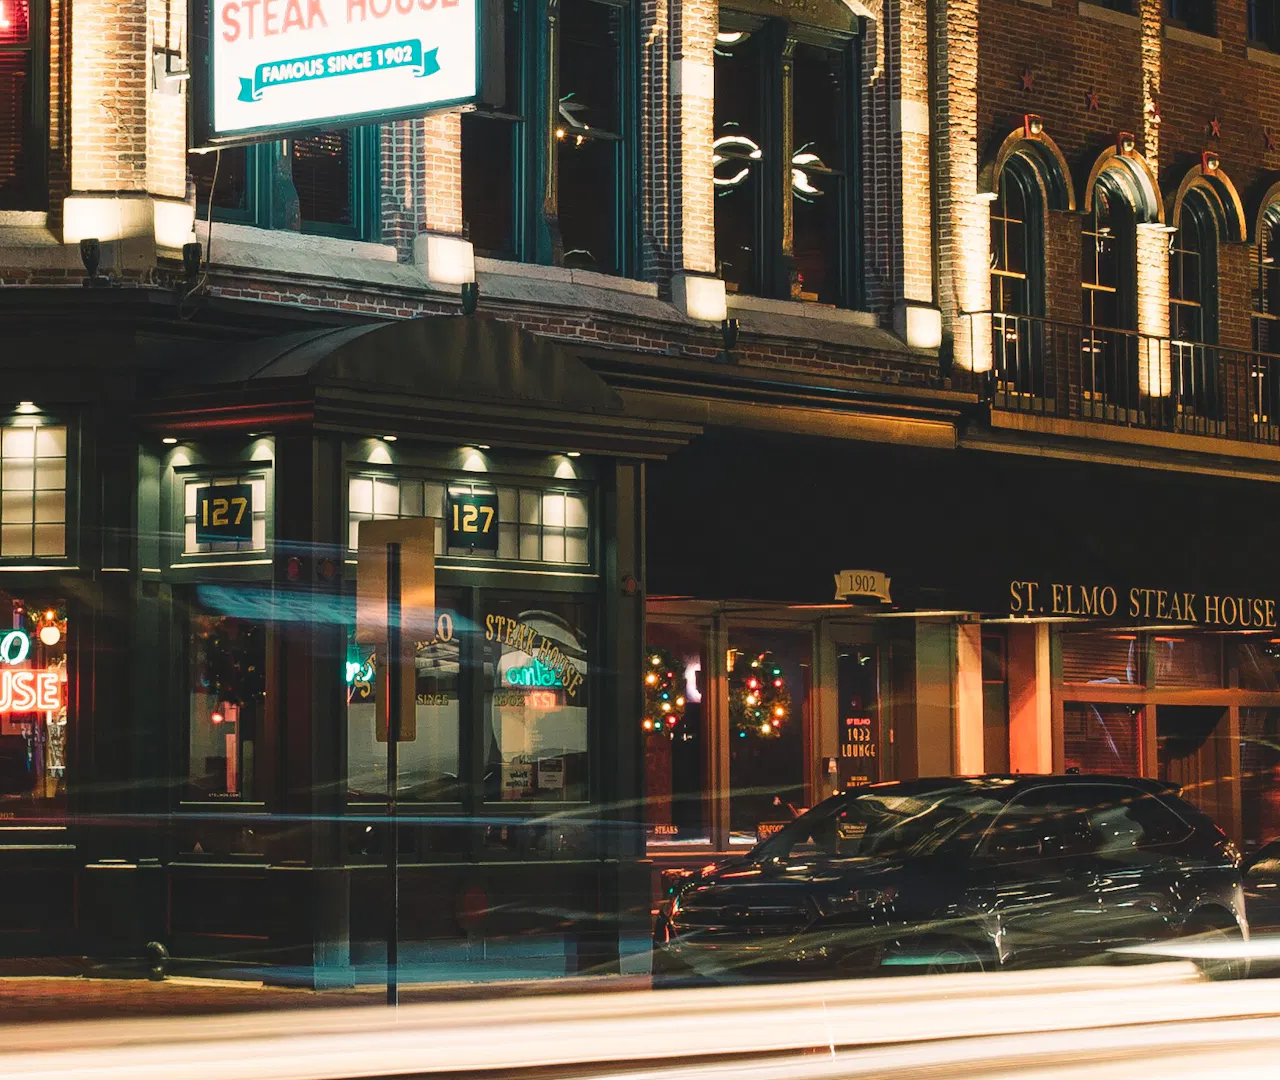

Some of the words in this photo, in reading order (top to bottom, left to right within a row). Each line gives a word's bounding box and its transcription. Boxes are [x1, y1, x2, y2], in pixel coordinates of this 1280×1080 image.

[262, 58, 324, 83] FAMOUS
[327, 52, 372, 73] SINCE
[377, 45, 413, 66] 1902
[202, 497, 248, 527] 127
[453, 505, 494, 533] 127
[849, 575, 876, 592] 1902
[1010, 580, 1044, 612] ST.
[1051, 584, 1117, 616] ELMO
[1129, 588, 1197, 621] STEAK
[1205, 595, 1277, 627] HOUSE
[485, 614, 538, 657] STEAK
[537, 636, 583, 697] HOUSE
[417, 693, 449, 705] SINCE
[848, 728, 870, 741] 1933
[842, 744, 875, 757] LOUNGE
[654, 825, 679, 834] STEAKS
